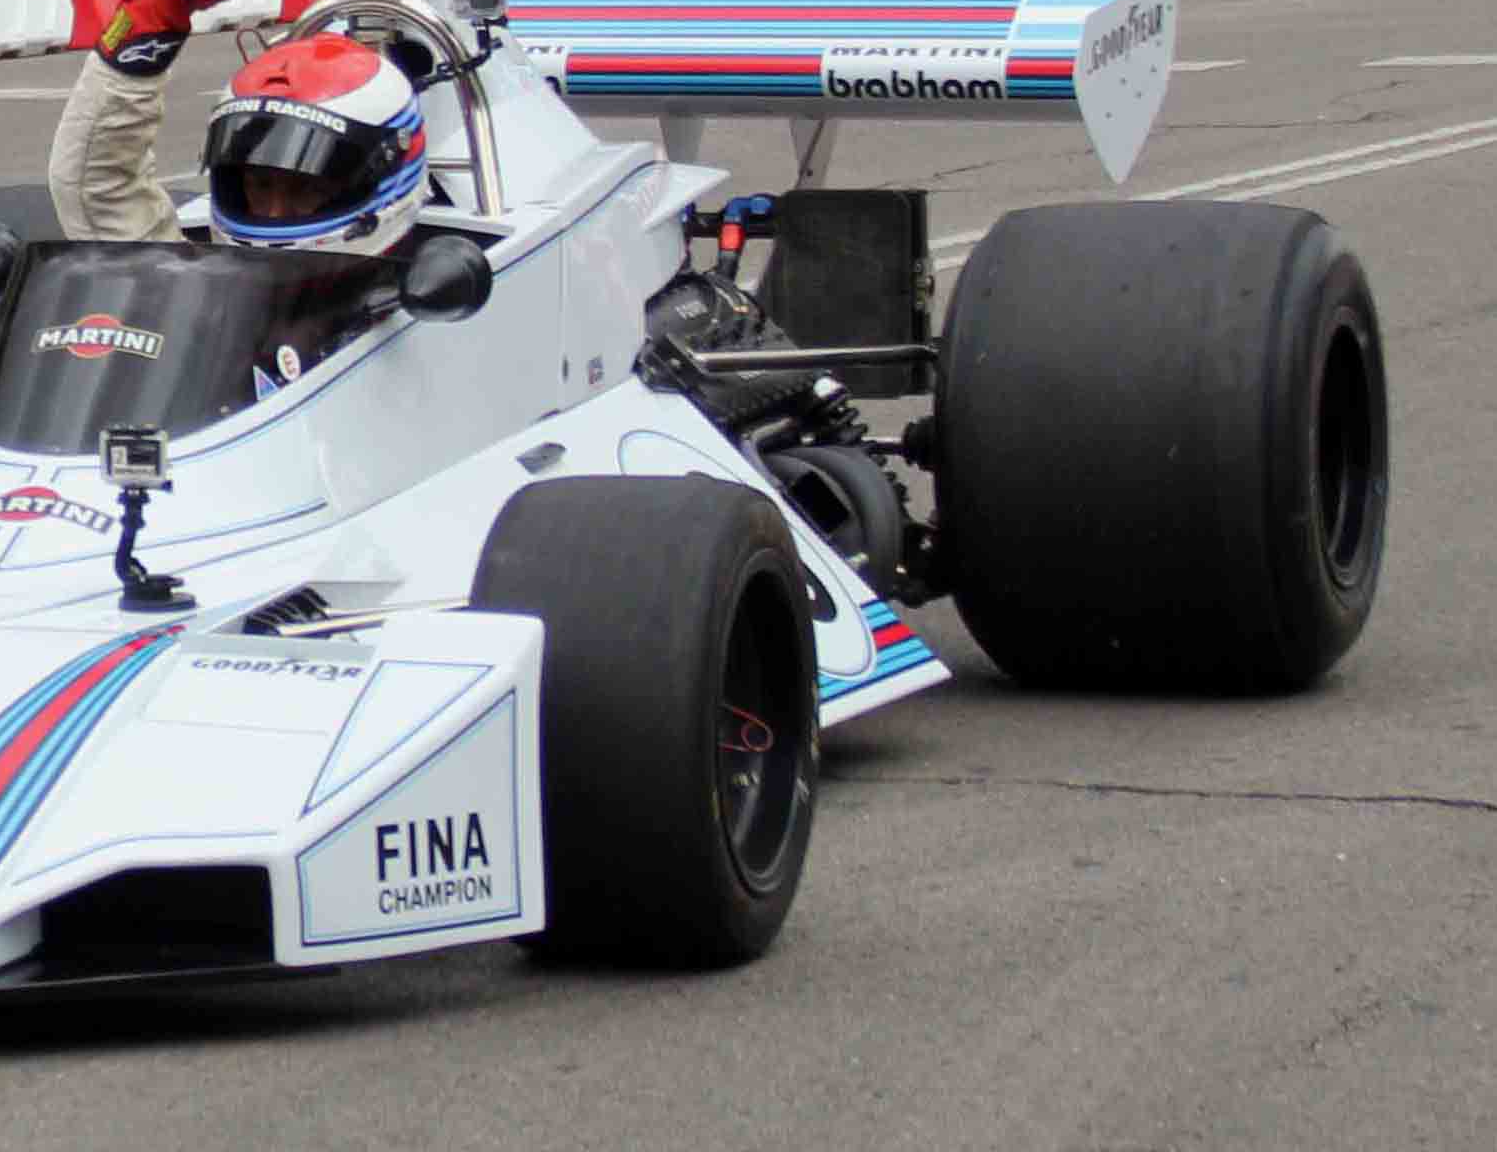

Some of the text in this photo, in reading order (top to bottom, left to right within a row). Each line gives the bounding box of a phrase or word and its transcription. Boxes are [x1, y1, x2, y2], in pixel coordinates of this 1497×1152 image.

[828, 69, 1002, 99] brabham
[264, 99, 348, 134] RACING
[37, 327, 156, 354] MARTINI
[376, 812, 489, 882] FINA
[378, 876, 493, 916] CHAMPION
